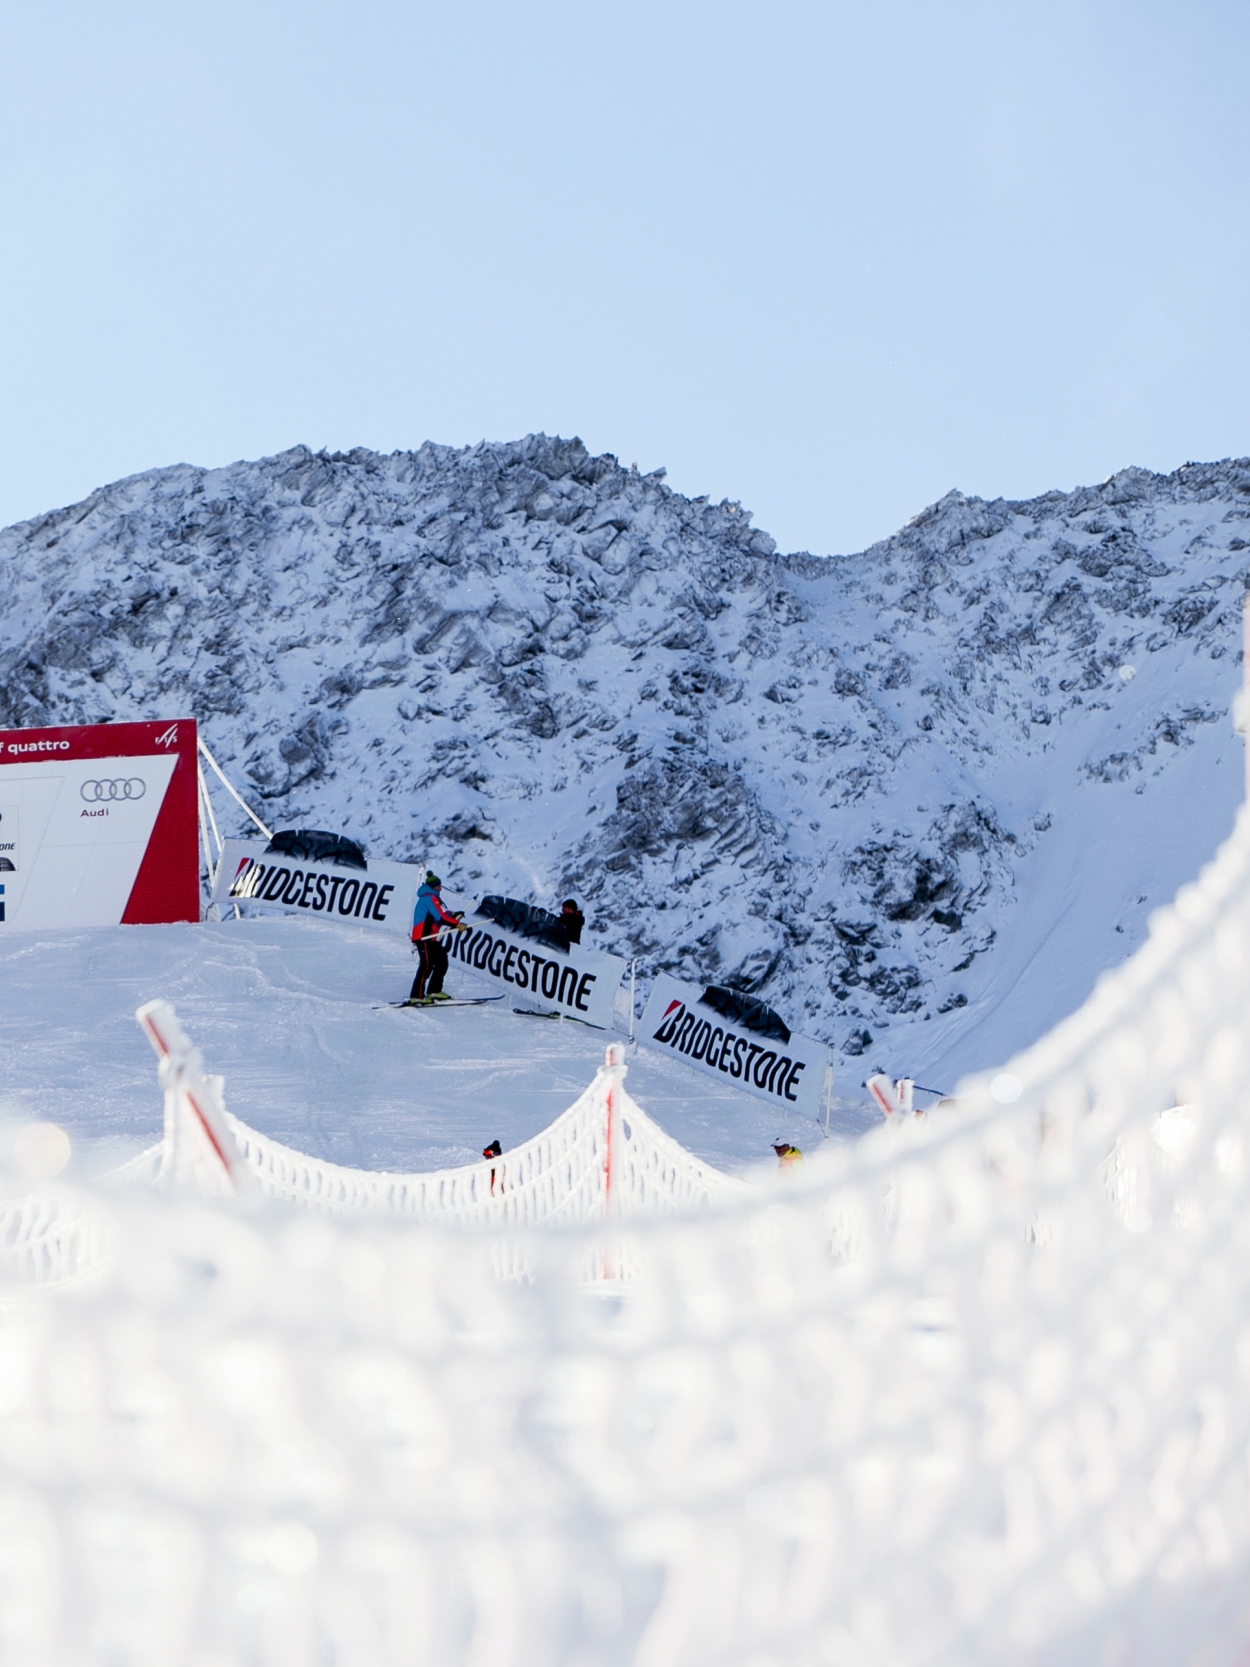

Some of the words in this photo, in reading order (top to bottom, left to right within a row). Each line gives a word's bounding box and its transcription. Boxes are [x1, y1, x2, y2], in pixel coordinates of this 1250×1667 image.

[8, 740, 71, 756] quattro
[80, 808, 109, 818] Audi
[653, 999, 807, 1102] BRIDGESTONE
